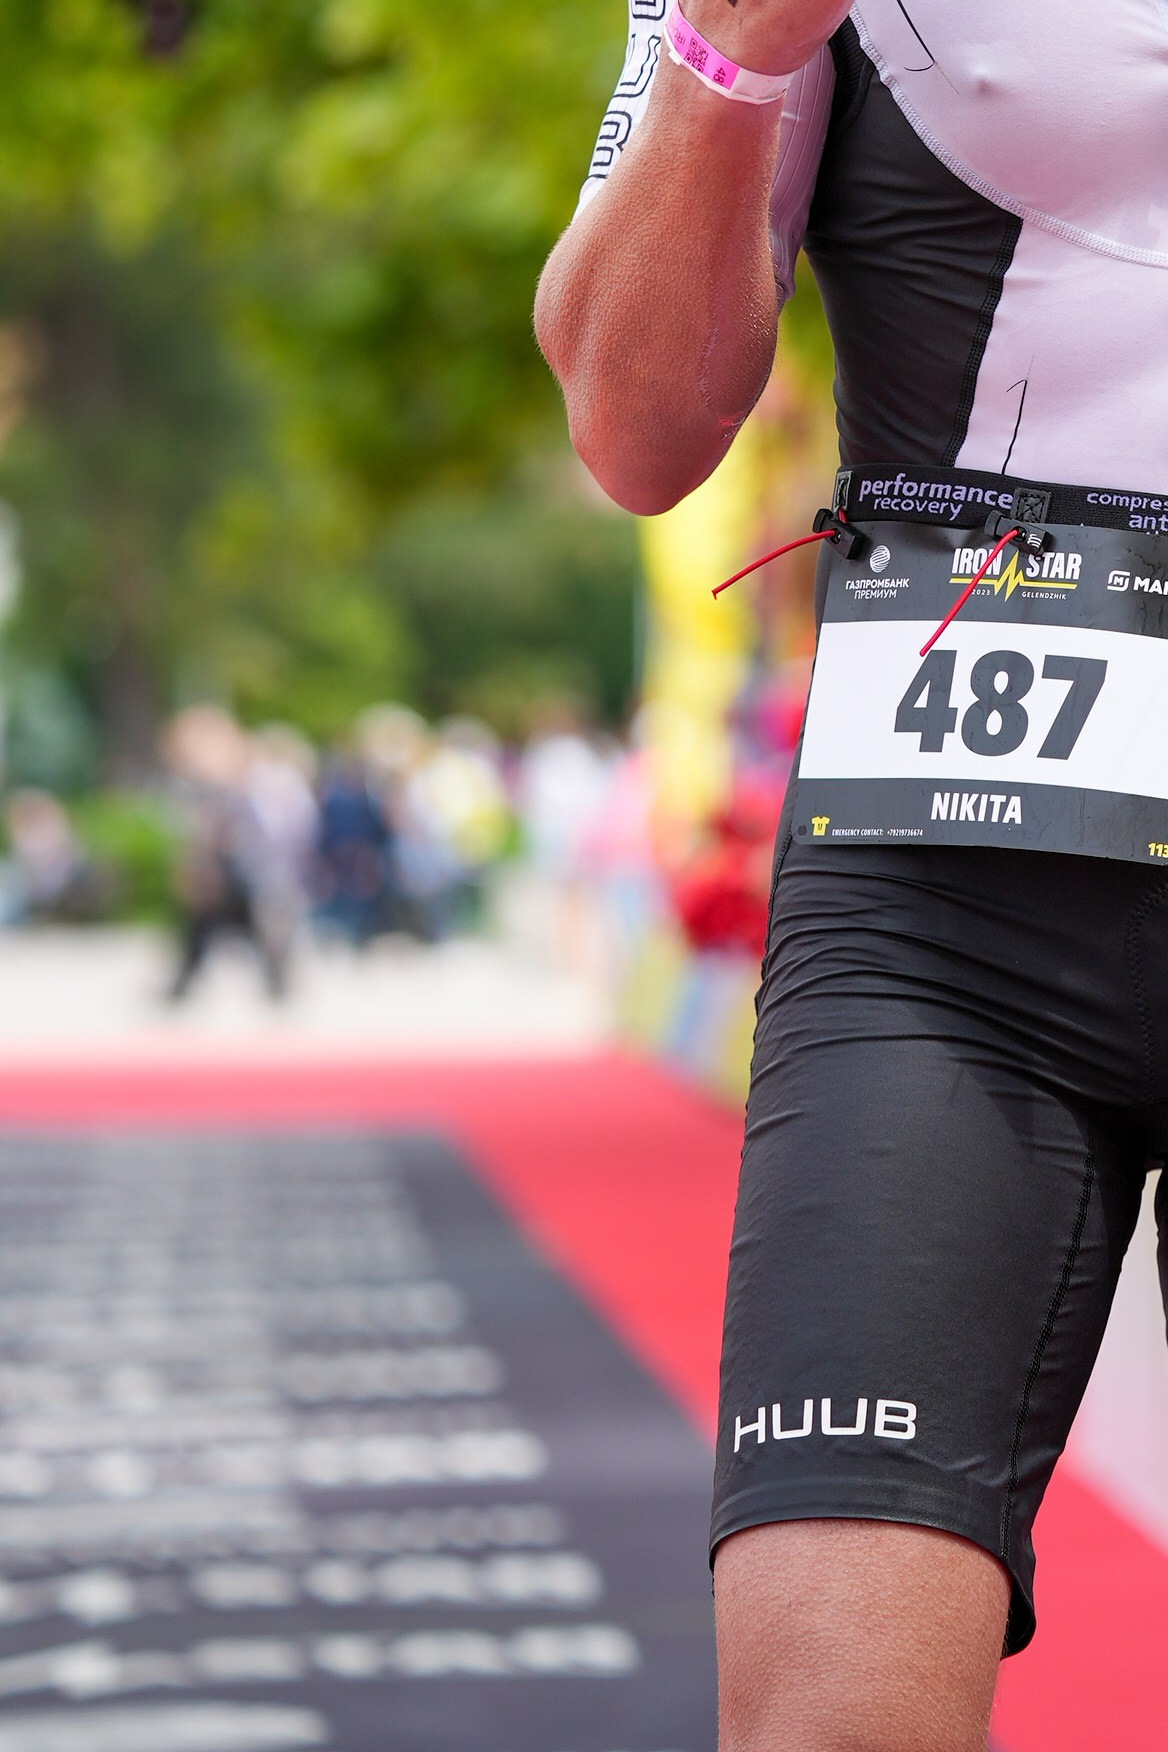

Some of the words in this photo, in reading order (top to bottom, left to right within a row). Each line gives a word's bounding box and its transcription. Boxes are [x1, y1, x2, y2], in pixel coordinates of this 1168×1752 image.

[859, 472, 1014, 510] performance
[873, 496, 963, 521] recovery
[951, 548, 1003, 576] IRON
[1026, 552, 1083, 580] STAR
[845, 578, 910, 590] ГАЗПРОМБАНК
[854, 589, 898, 600] ПРЕМИУМ
[1021, 591, 1067, 600] GELENDZHIK
[894, 650, 1108, 760] 487
[930, 792, 1022, 824] NIKITA
[832, 828, 860, 837] EMERGENCY
[860, 828, 884, 837] CONTACT:
[733, 1398, 918, 1453] HUUB
